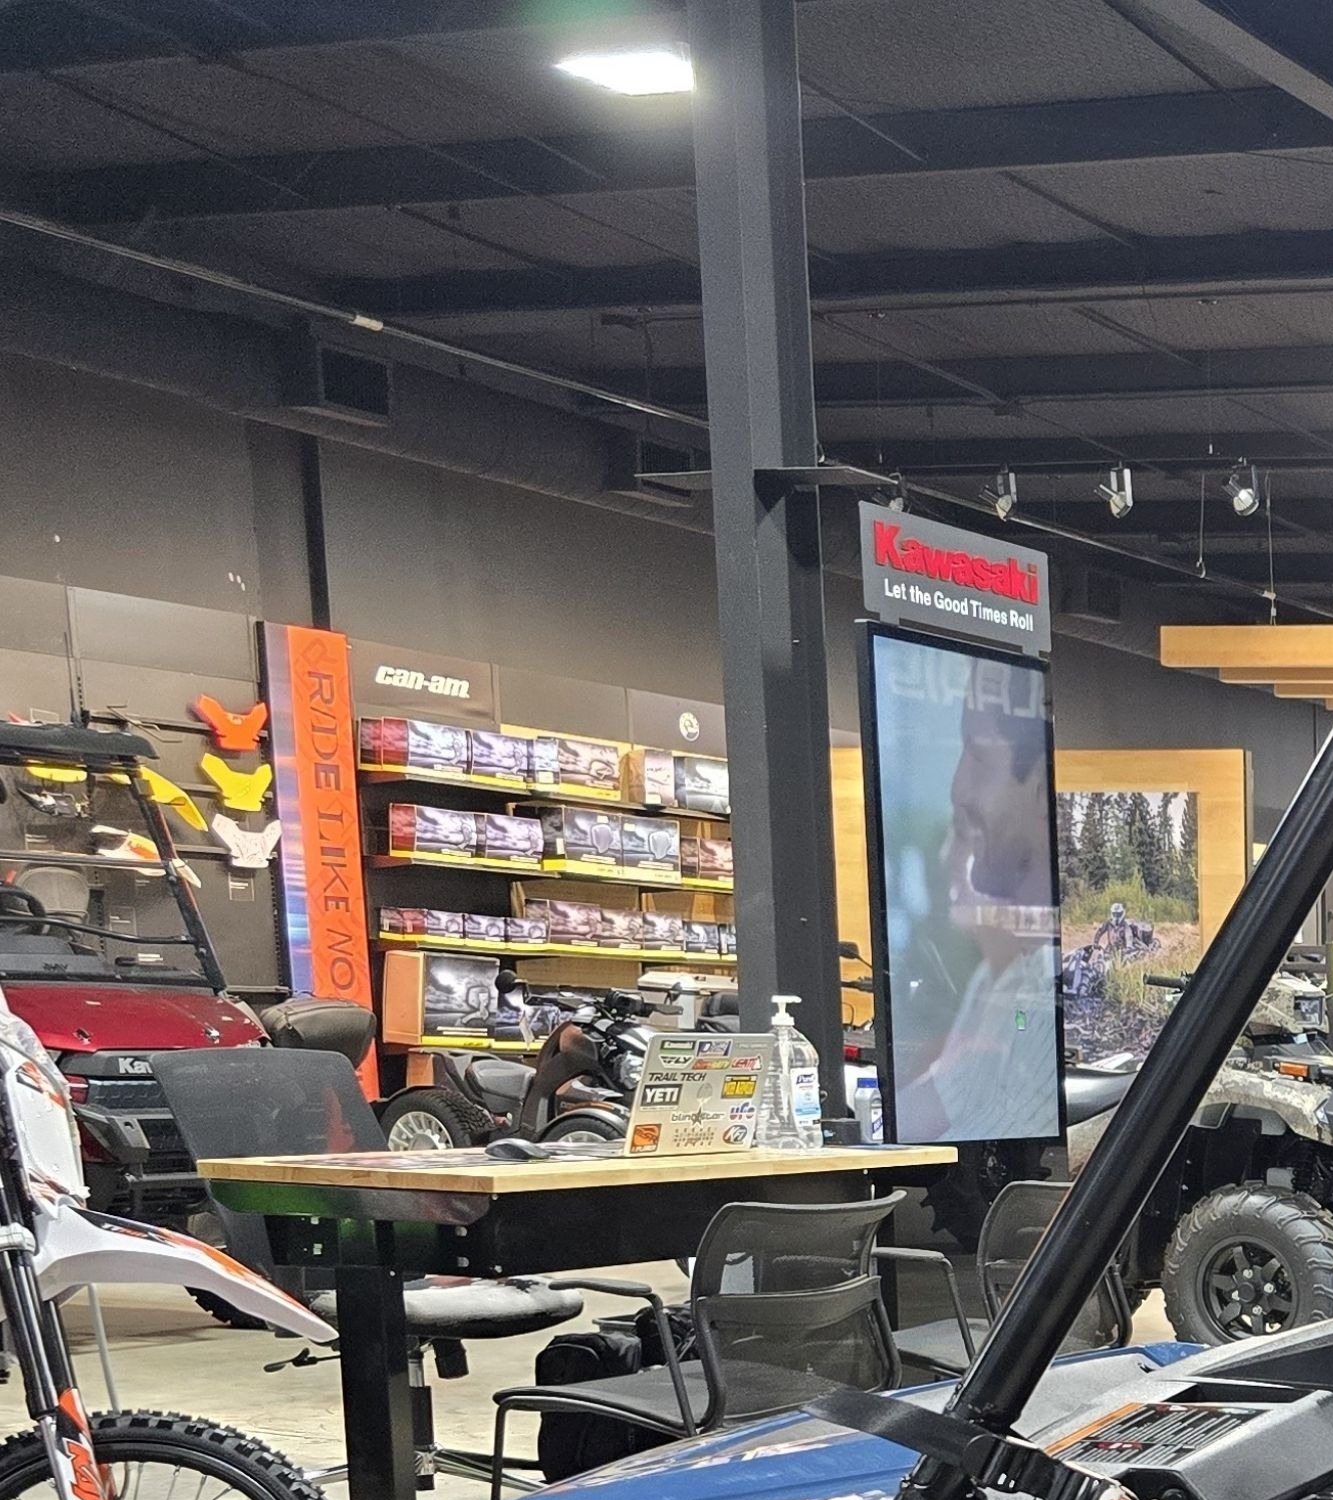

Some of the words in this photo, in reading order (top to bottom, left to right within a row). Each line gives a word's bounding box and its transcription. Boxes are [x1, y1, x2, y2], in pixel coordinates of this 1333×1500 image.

[873, 520, 1039, 605] Kawasaki
[884, 578, 907, 600] Let
[909, 585, 932, 606] the
[934, 591, 968, 616] Good
[970, 600, 1008, 625] Times
[1010, 609, 1034, 632] Roll
[375, 664, 470, 698] can-am
[306, 670, 342, 792] RIDE
[316, 806, 350, 914] LIKE
[326, 927, 357, 991] NO
[645, 1087, 680, 1103] YETI
[648, 1072, 679, 1082] TRAIL
[680, 1072, 707, 1082] TECH
